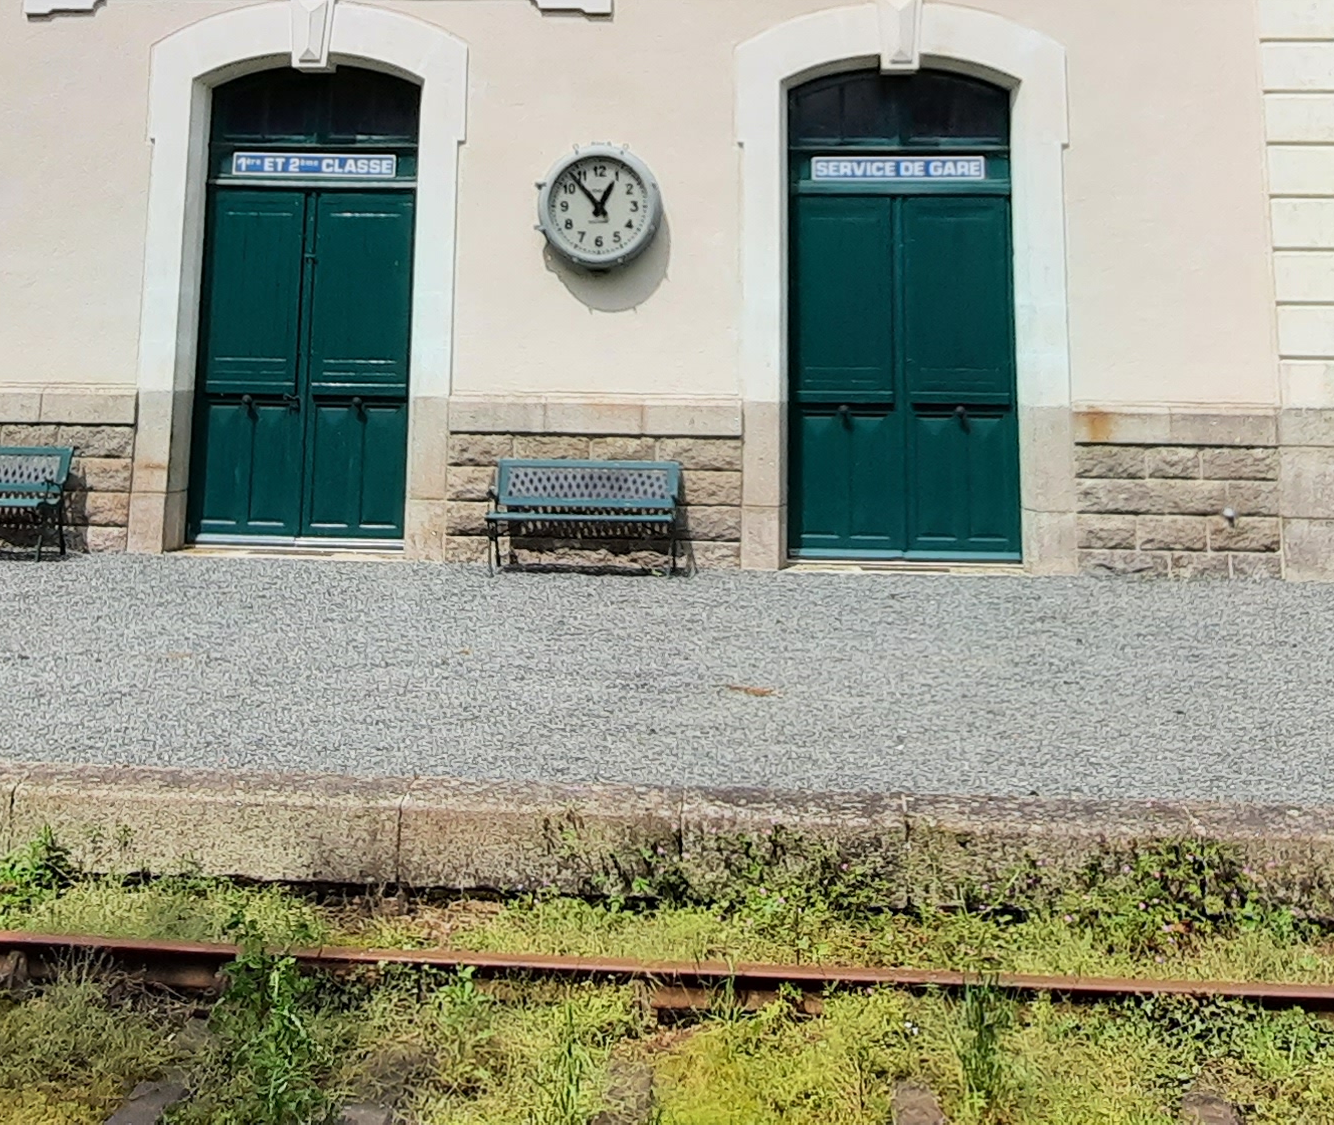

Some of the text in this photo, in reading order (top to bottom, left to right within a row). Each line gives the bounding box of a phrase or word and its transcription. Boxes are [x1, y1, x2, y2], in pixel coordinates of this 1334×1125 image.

[263, 157, 286, 172] ET
[321, 158, 393, 174] CLASSE
[593, 165, 607, 177] 12
[816, 161, 981, 176] SERVICE DE GARE
[614, 170, 620, 181] 1
[563, 183, 576, 194] 10
[626, 183, 634, 195] 2
[560, 201, 569, 212] 9
[630, 201, 639, 212] 3
[564, 218, 573, 230] 8
[624, 219, 634, 229] 4
[577, 231, 586, 243] 7
[594, 236, 603, 247] 6
[613, 231, 621, 243] 5
